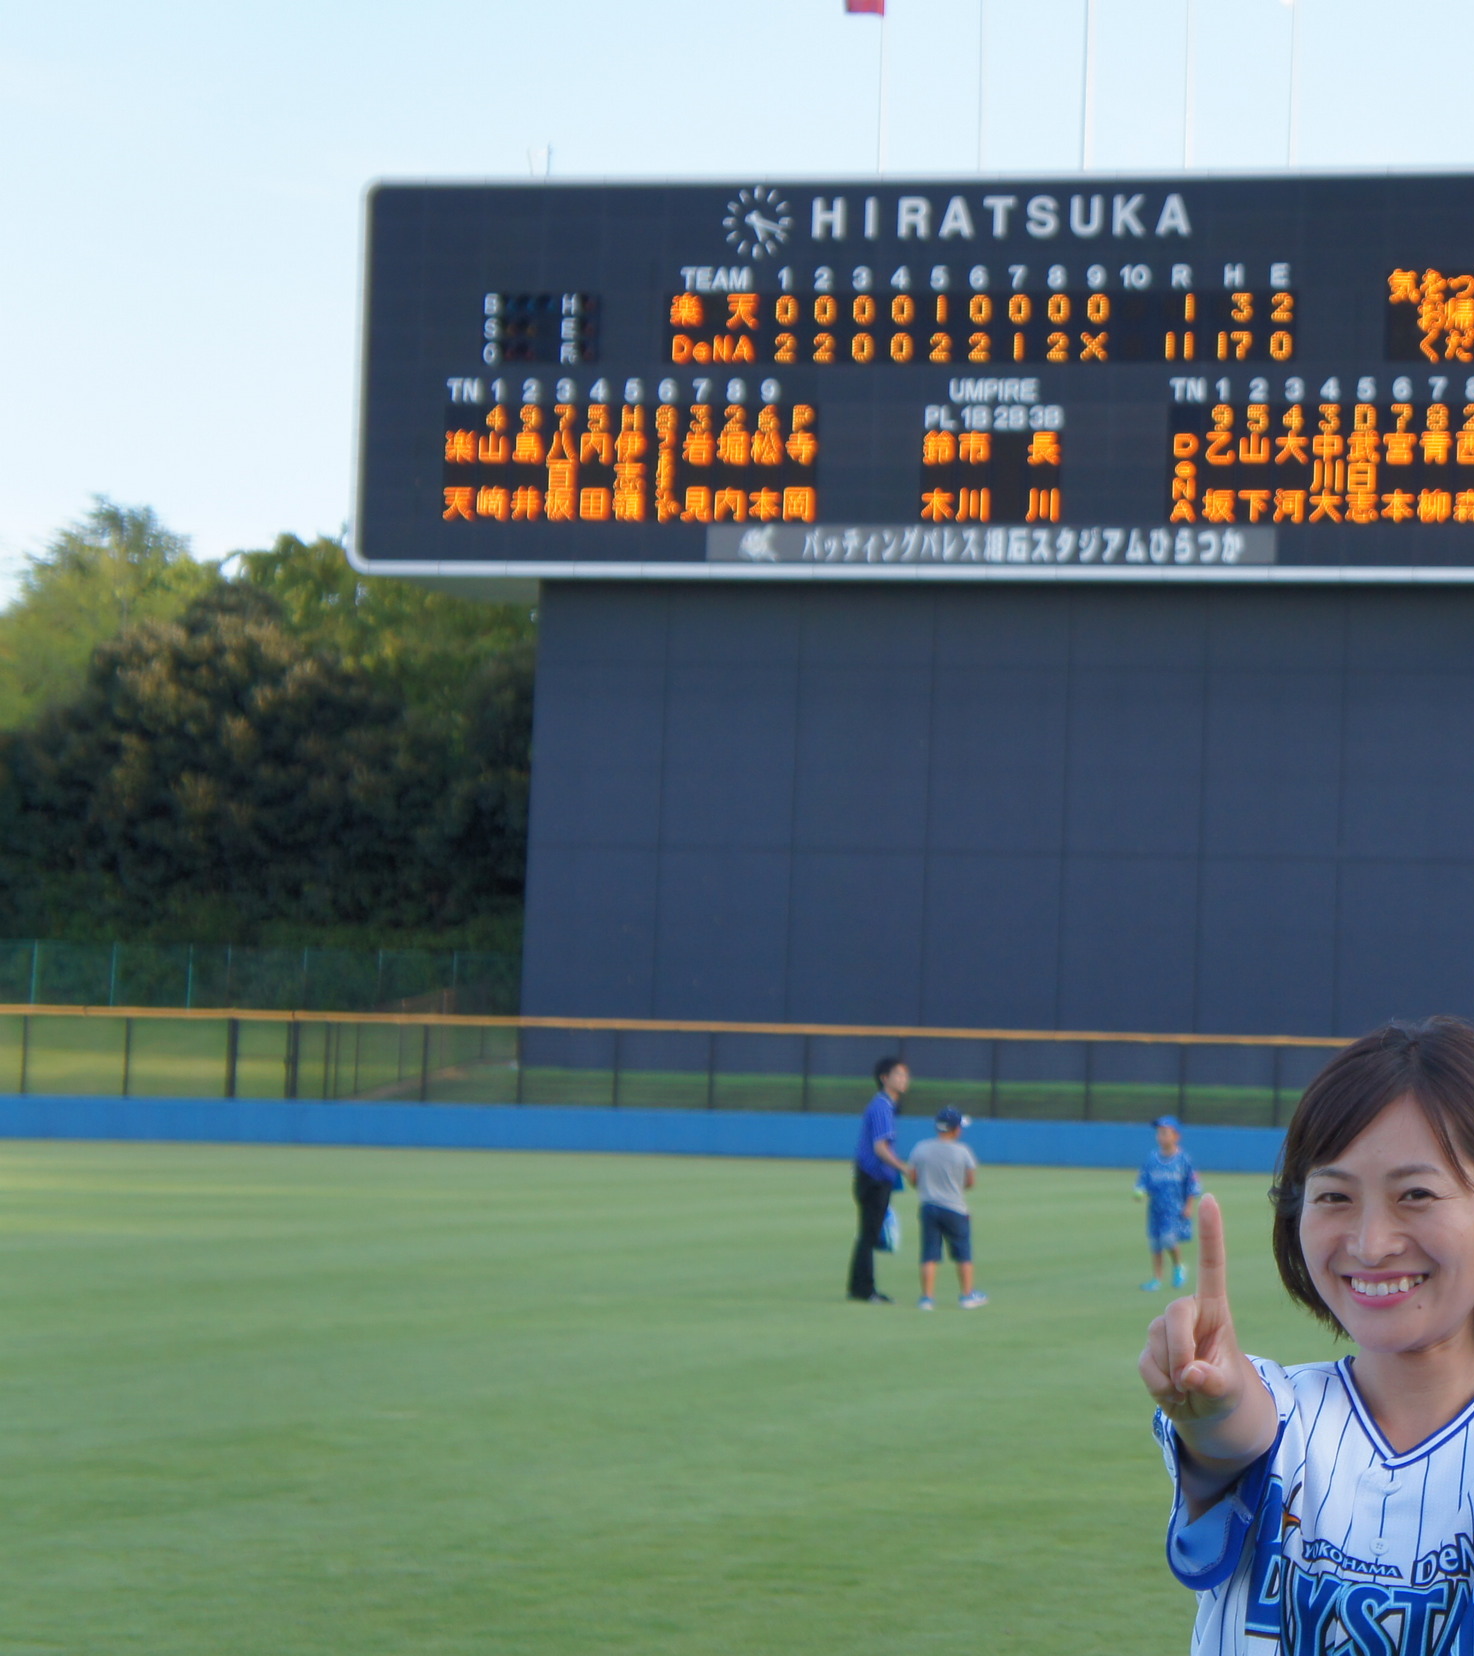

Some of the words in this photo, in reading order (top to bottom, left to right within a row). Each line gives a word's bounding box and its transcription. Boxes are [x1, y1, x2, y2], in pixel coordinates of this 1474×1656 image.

[811, 194, 1192, 240] HIRATSUKA
[681, 266, 753, 292] TEAM
[778, 266, 793, 292] 1
[814, 266, 834, 292] 2
[852, 266, 872, 292] 3
[891, 265, 911, 291] 4
[930, 265, 949, 290] 5
[969, 265, 989, 290] 6
[1008, 265, 1028, 290] 7
[1047, 264, 1067, 290] 8
[1087, 264, 1107, 290] 9
[1120, 264, 1152, 289] 10
[1172, 263, 1192, 289] R
[1224, 263, 1245, 288] H
[1270, 262, 1290, 288] E
[776, 294, 799, 325] 0
[814, 294, 837, 325] 0
[853, 294, 875, 325] 0
[892, 294, 914, 325] 0
[937, 294, 948, 325] 1
[970, 294, 992, 325] 0
[1009, 294, 1031, 325] 0
[1048, 294, 1071, 325] 0
[1087, 294, 1110, 325] 0
[1185, 293, 1195, 323] 1
[1231, 292, 1254, 322] 3
[1270, 292, 1293, 322] 2
[672, 334, 756, 364] DeNA
[774, 332, 797, 363] 2
[813, 332, 836, 363] 2
[851, 332, 874, 363] 0
[890, 332, 913, 363] 0
[929, 332, 952, 363] 2
[968, 332, 991, 363] 2
[1014, 332, 1025, 363] 1
[1047, 332, 1069, 363] 2
[1165, 331, 1194, 361] 11
[1217, 331, 1252, 361] 17
[1270, 331, 1292, 361] 0
[447, 377, 482, 403] TN
[491, 377, 506, 403] 1
[522, 377, 541, 403] 2
[556, 377, 576, 403] 3
[589, 377, 610, 403] 4
[624, 377, 644, 403] 5
[658, 377, 678, 403] 6
[692, 377, 712, 403] 7
[726, 377, 747, 403] 8
[761, 377, 780, 403] 9
[949, 378, 1040, 403] UMPIRE
[1169, 376, 1207, 402] TN
[1215, 376, 1230, 402] 1
[1249, 376, 1269, 402] 2
[1284, 376, 1305, 402] 3
[1320, 376, 1341, 402] 4
[1357, 376, 1376, 402] 5
[1392, 376, 1413, 402] 6
[1428, 376, 1448, 402] 7
[925, 404, 958, 431] PL
[961, 404, 991, 431] 1B
[993, 404, 1028, 431] 2B
[1029, 404, 1064, 431] 3B
[1302, 1539, 1403, 1580] YOKOHAMA
